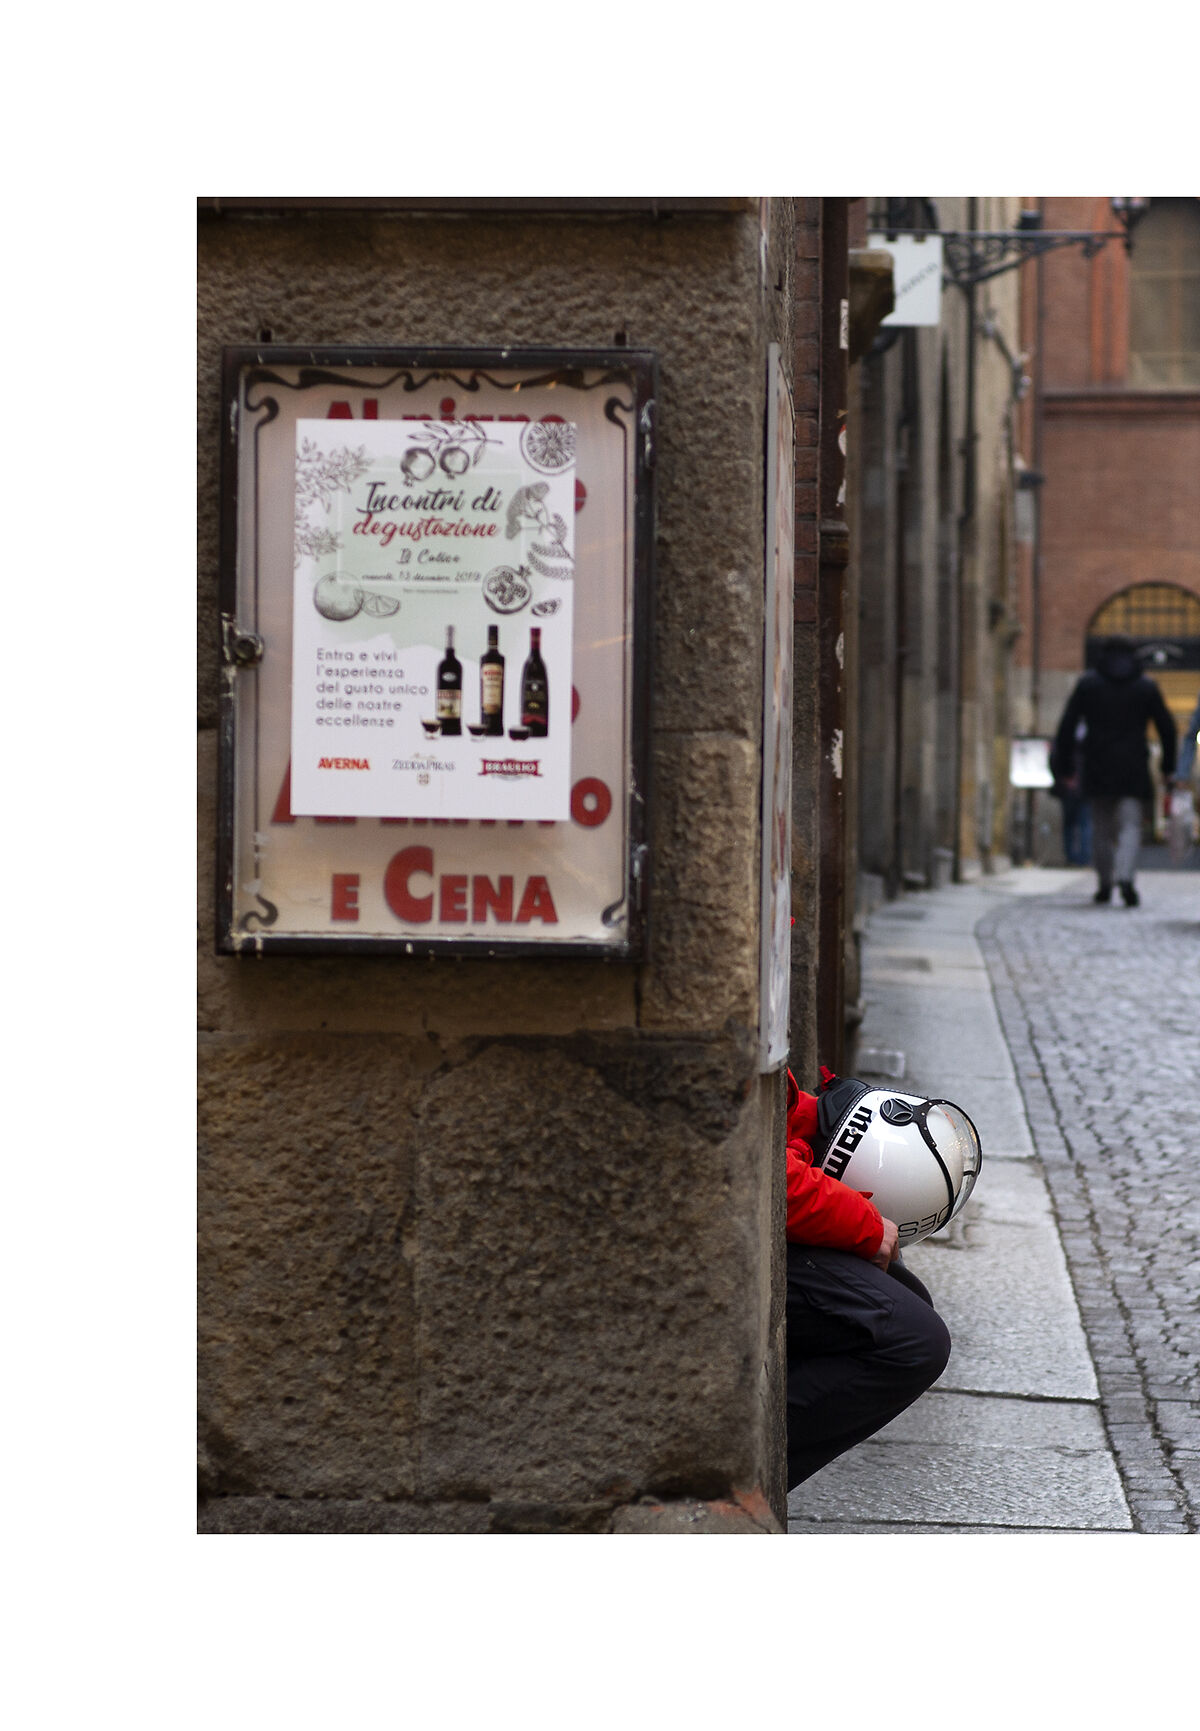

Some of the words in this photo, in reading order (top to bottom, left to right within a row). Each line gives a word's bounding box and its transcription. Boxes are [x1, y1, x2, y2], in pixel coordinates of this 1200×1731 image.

[356, 481, 465, 513] Incontri
[471, 486, 502, 511] di
[352, 511, 499, 547] degustazione
[316, 647, 354, 661] Entra
[359, 651, 368, 661] e
[373, 650, 398, 661] vivi
[316, 664, 404, 679] l'esperienza
[316, 681, 339, 693] del
[344, 683, 383, 696] gusto
[388, 684, 429, 695] unico
[316, 697, 352, 710] delle
[358, 699, 402, 711] nostre
[315, 714, 395, 727] eccellenze
[318, 757, 369, 770] AVERNA
[331, 874, 360, 922] E
[384, 845, 558, 924] CENA
